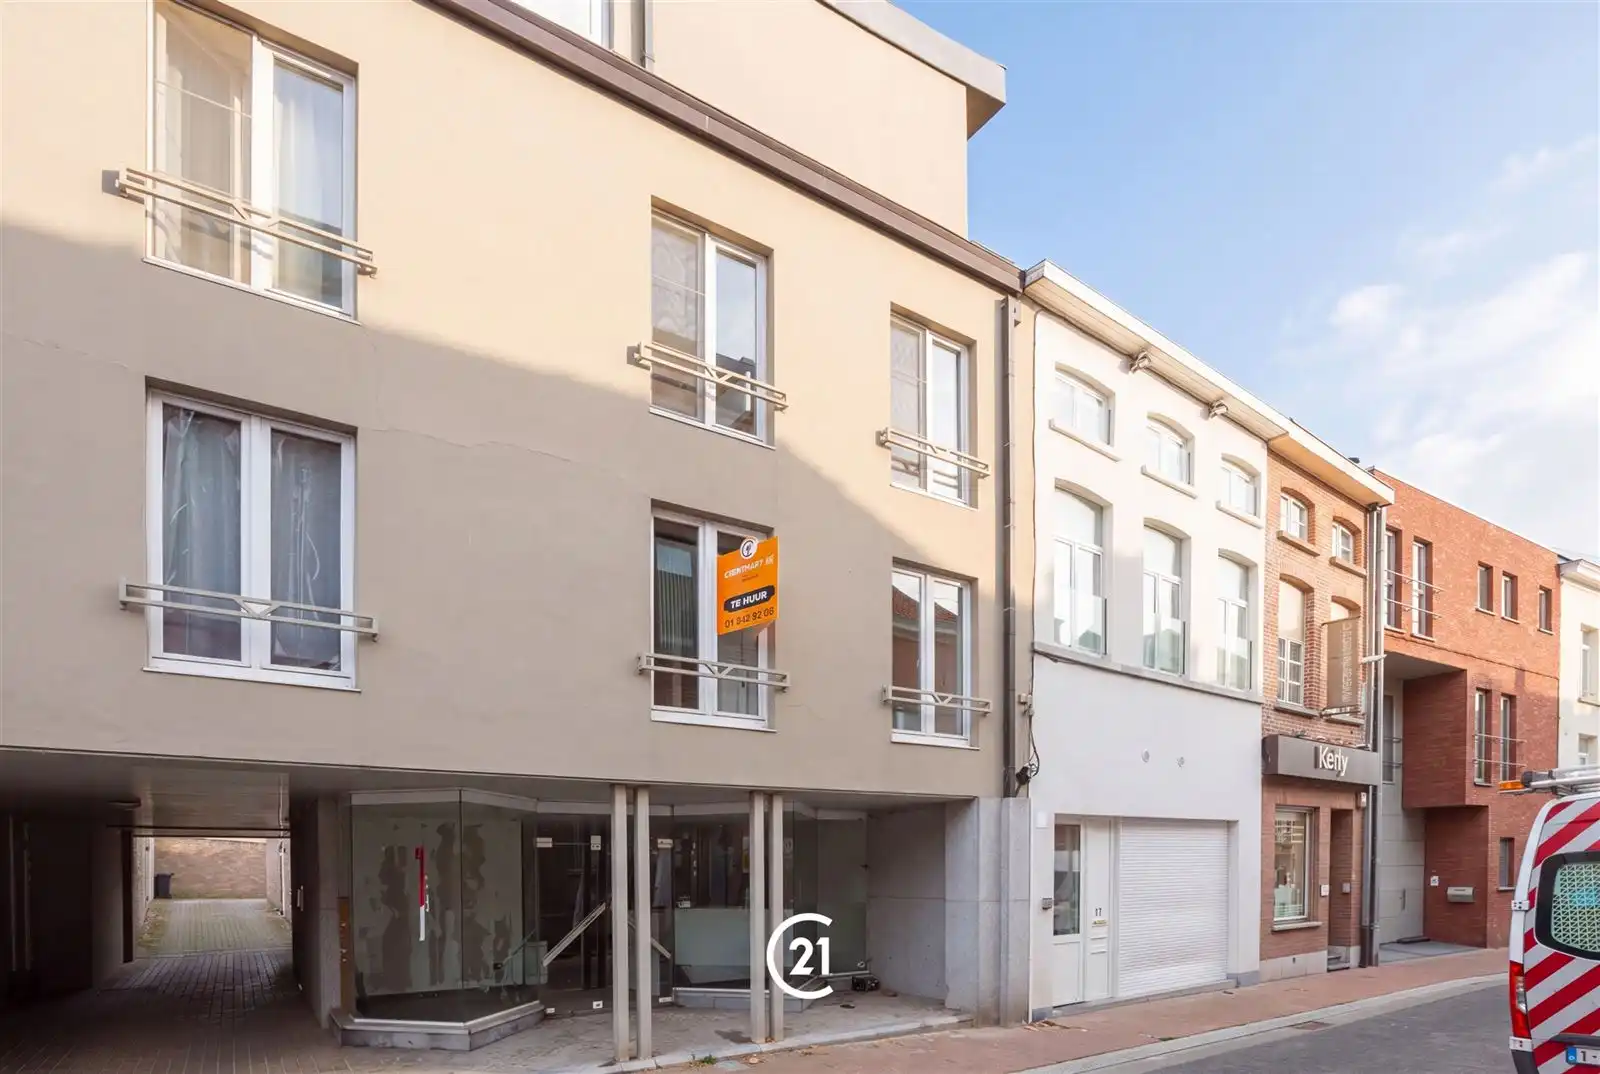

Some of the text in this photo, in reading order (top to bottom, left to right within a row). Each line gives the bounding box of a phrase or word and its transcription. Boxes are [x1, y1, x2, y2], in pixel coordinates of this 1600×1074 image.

[730, 590, 768, 609] TE HUUR
[1319, 745, 1348, 777] Kerly
